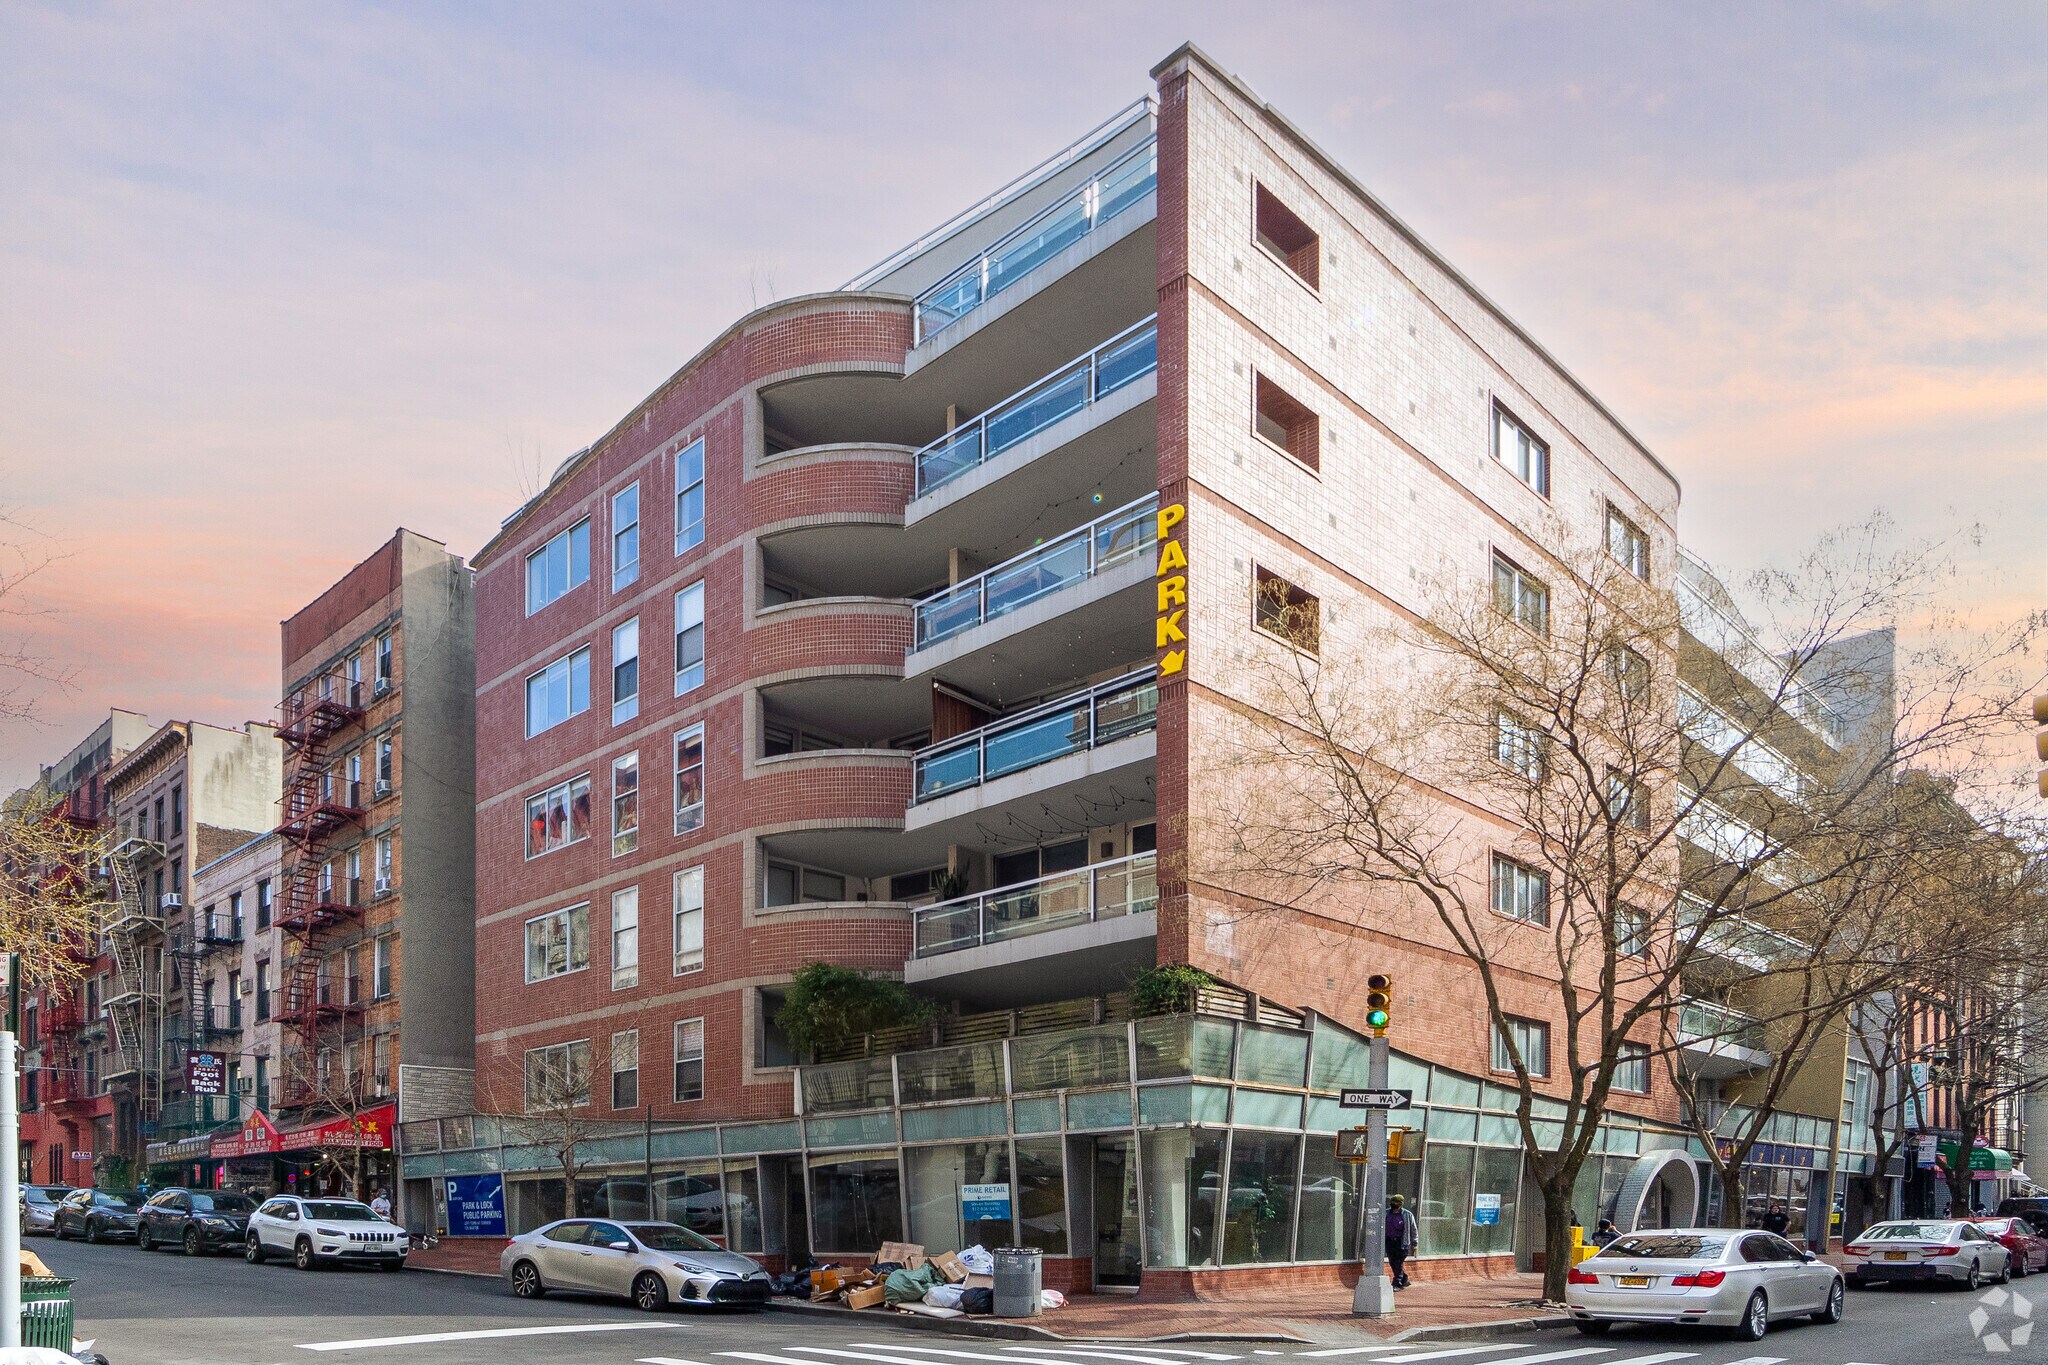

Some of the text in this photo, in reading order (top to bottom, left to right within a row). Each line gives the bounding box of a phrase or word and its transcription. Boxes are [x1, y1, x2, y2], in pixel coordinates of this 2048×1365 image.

[1156, 504, 1187, 648] PARK
[191, 1079, 220, 1087] Back
[1350, 1095, 1400, 1104] ONE WAY
[964, 1186, 983, 1194] PRIME
[462, 1200, 494, 1210] PARK & LOCK
[463, 1210, 502, 1219] PUBLIC PARKING
